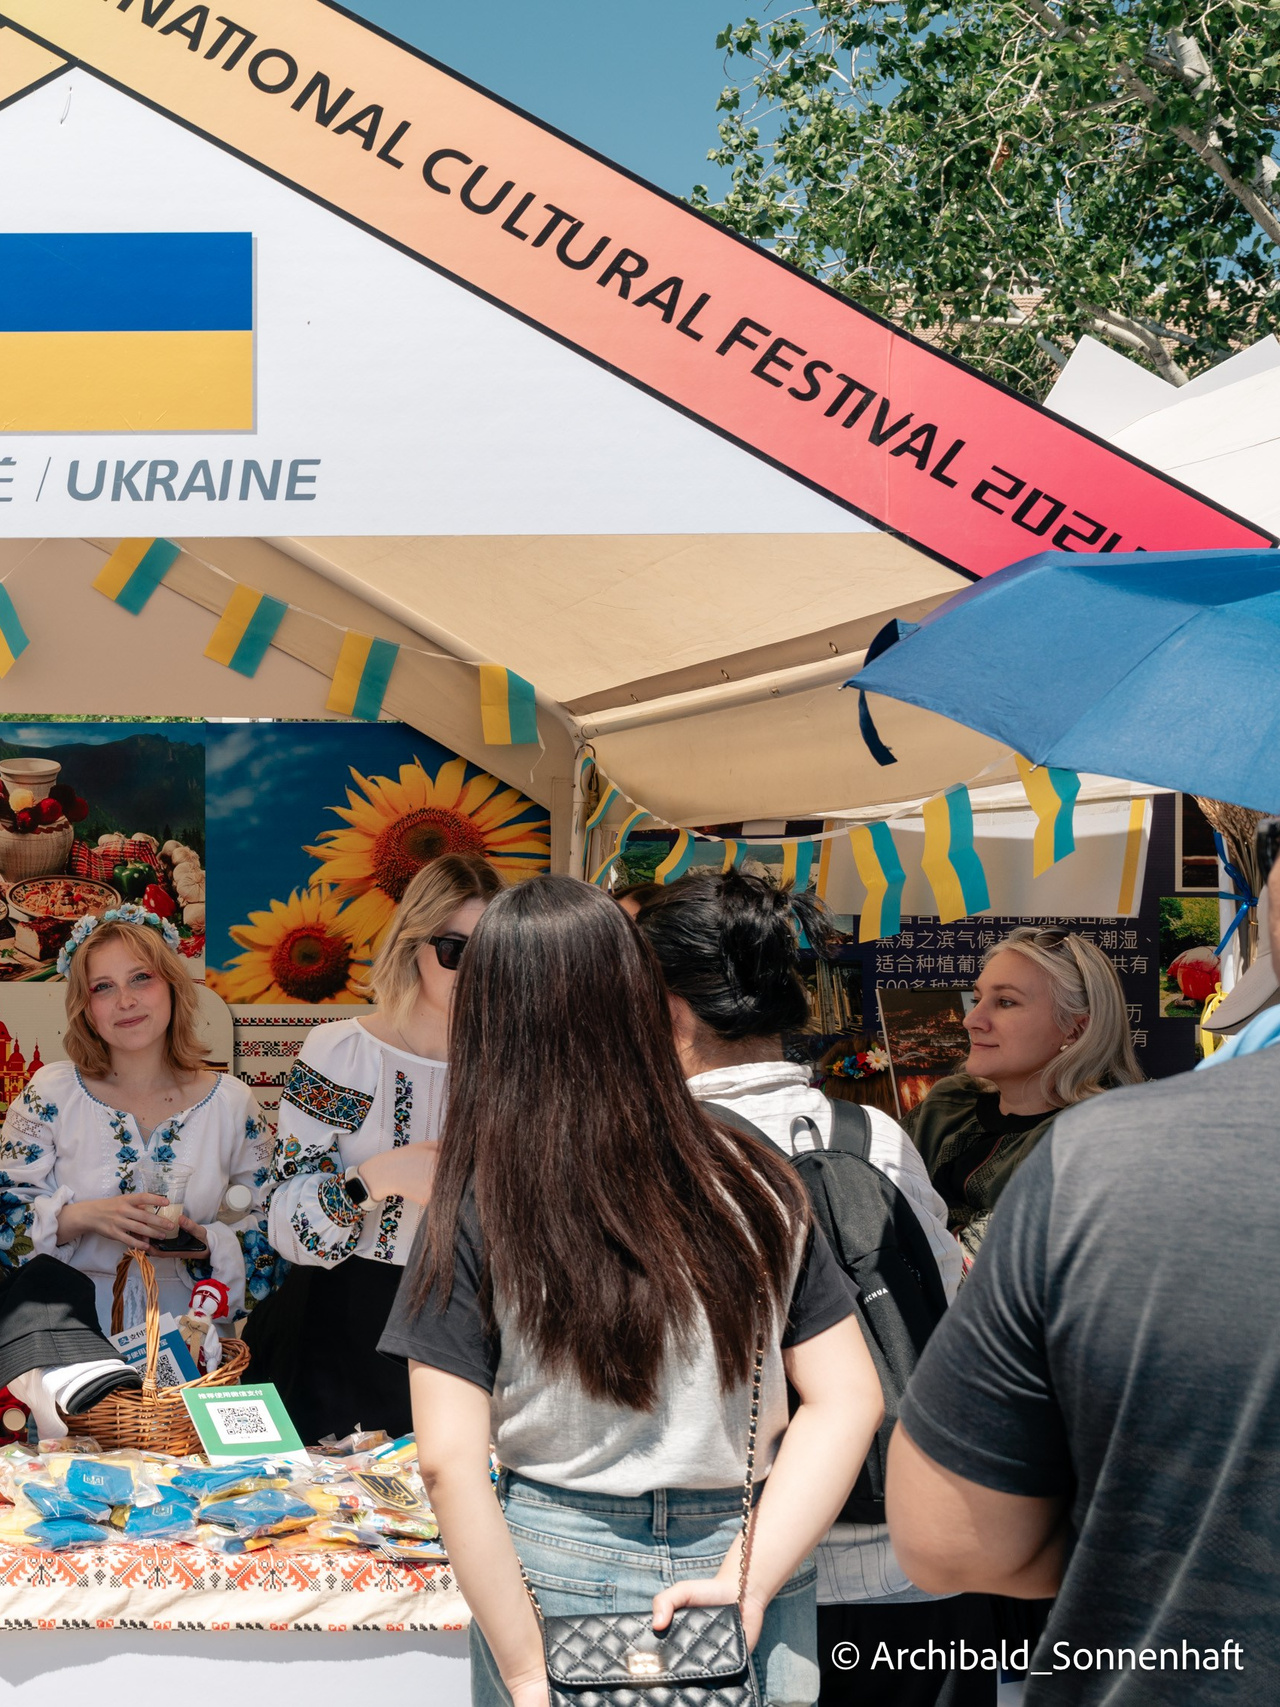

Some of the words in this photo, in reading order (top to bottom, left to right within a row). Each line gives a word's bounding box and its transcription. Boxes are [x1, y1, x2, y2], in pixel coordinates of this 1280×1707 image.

[422, 148, 711, 342] CULTURAL
[715, 317, 965, 488] FESTIVAL
[971, 465, 1147, 553] 202
[67, 459, 321, 502] UKRAINE
[130, 1328, 147, 1341] 支付
